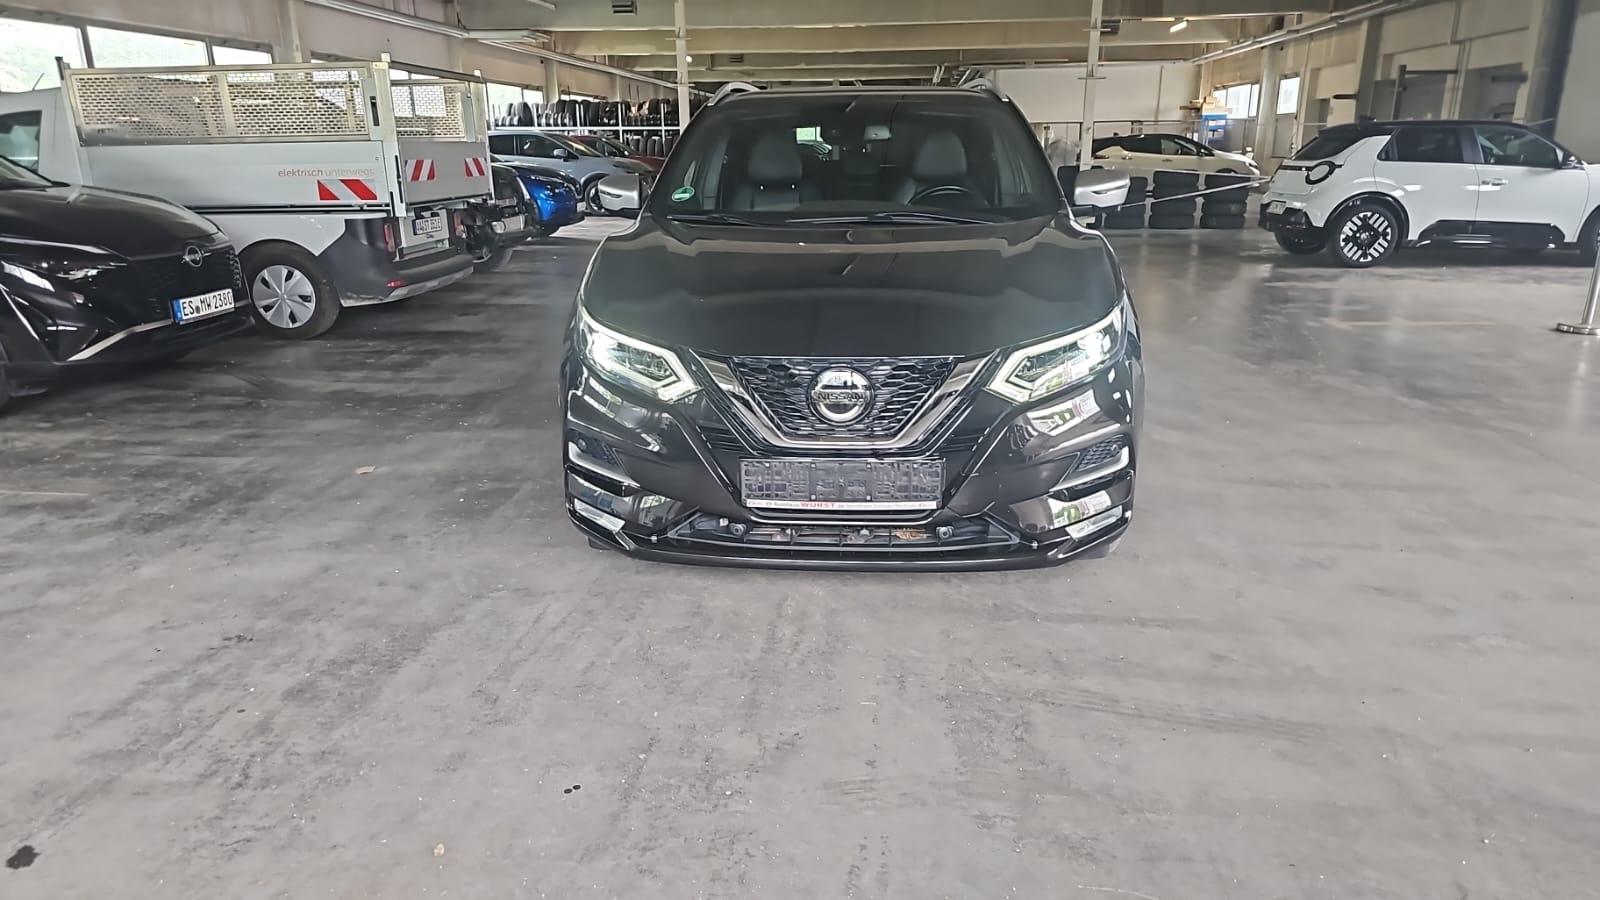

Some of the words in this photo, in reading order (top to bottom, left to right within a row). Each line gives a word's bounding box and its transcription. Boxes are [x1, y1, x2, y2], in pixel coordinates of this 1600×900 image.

[278, 168, 323, 177] elektrisch
[325, 168, 375, 178] unterwegs
[181, 300, 195, 317] ES
[200, 295, 212, 313] MW
[212, 291, 233, 310] 2380
[817, 391, 864, 401] NISSAN
